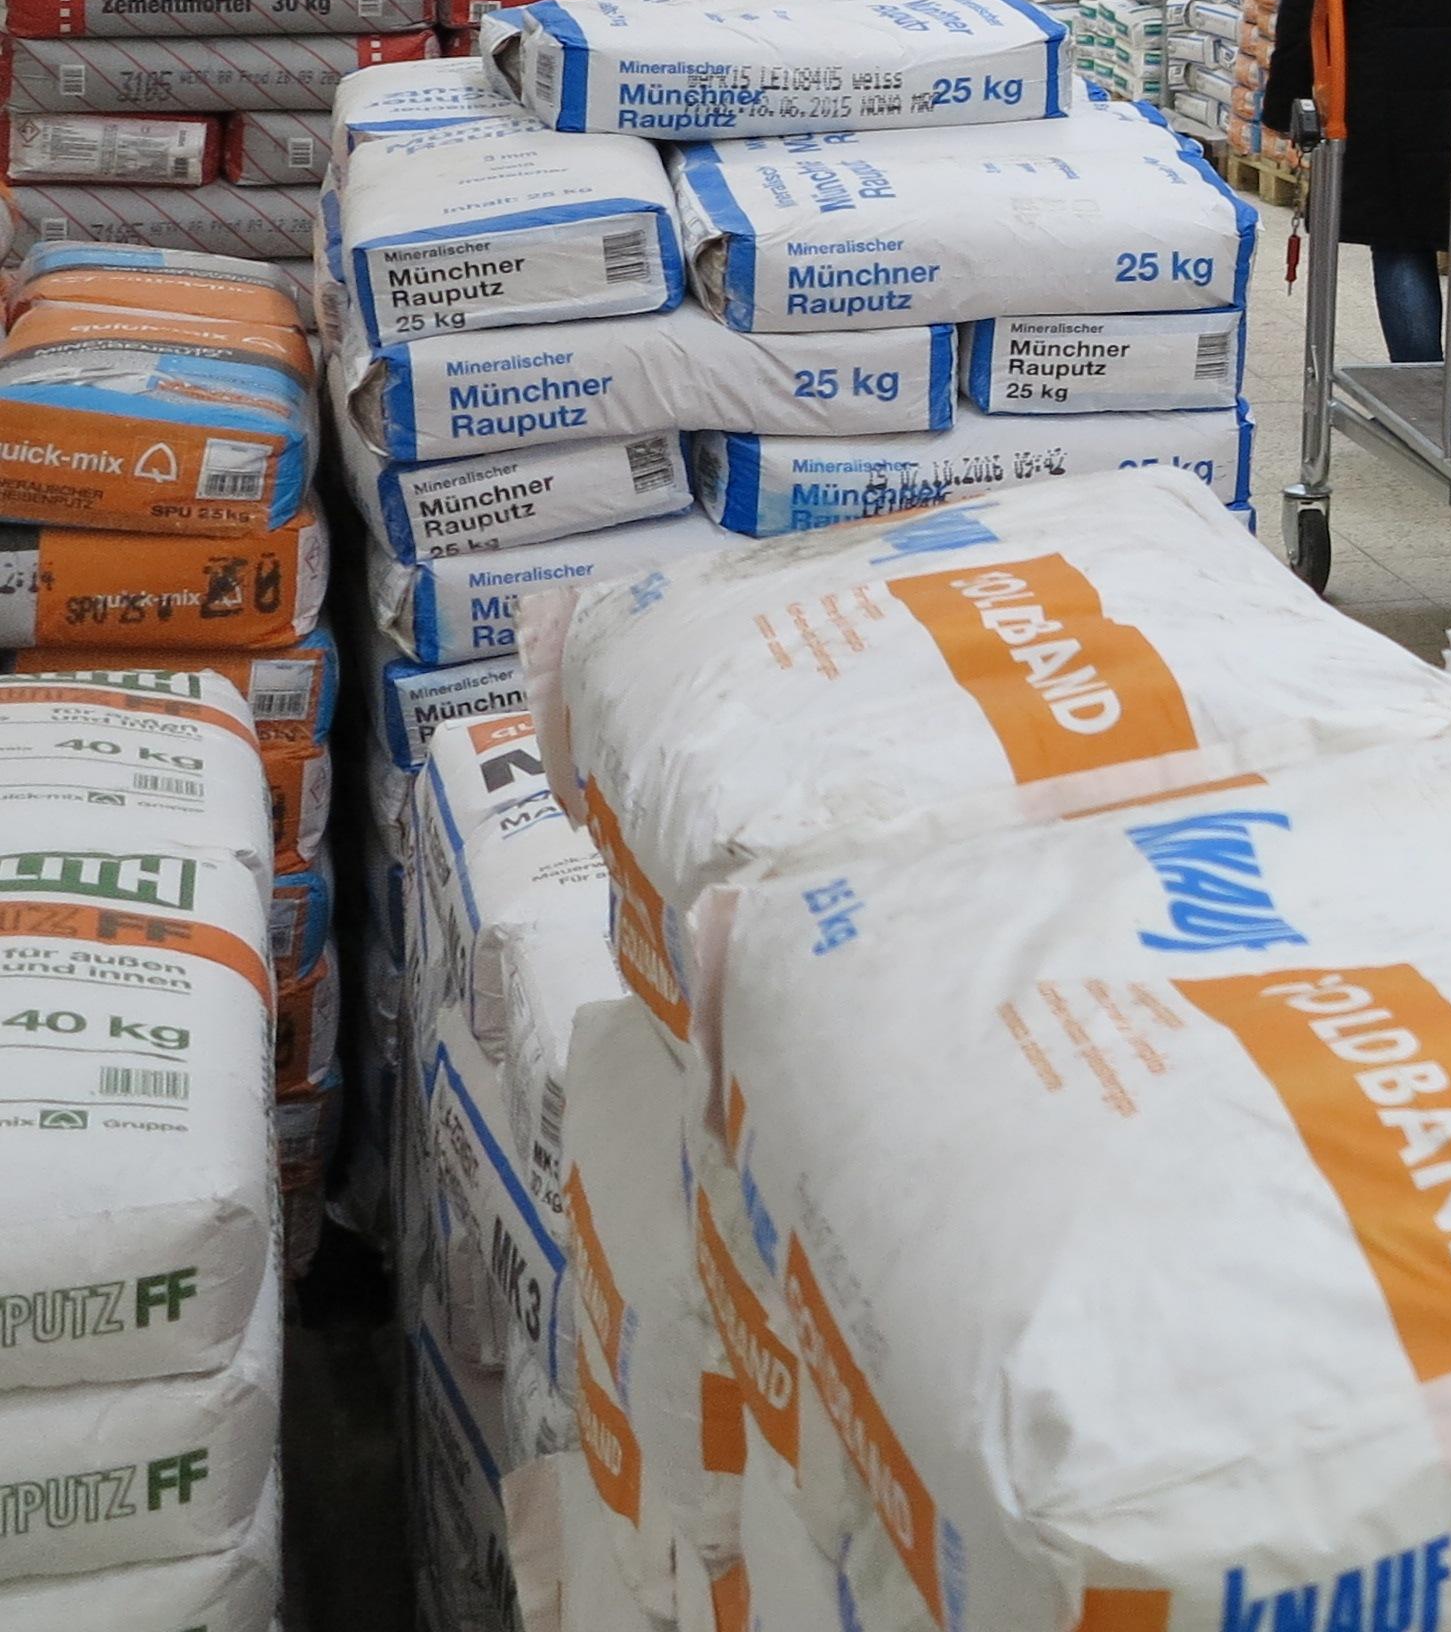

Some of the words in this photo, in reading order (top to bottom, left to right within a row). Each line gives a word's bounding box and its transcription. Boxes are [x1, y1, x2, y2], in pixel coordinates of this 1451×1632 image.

[932, 76, 974, 107] 25
[981, 75, 1023, 108] kg
[384, 239, 491, 264] Mineralischer
[786, 236, 905, 259] Mineralischer
[387, 254, 525, 288] Münchner
[788, 260, 941, 290] Münchner
[1114, 253, 1163, 282] 25
[1171, 252, 1215, 289] kg
[389, 278, 505, 309] Rauputz
[786, 288, 912, 318] Rauputz
[394, 313, 426, 333] 25
[434, 309, 466, 331] kg
[1009, 321, 1105, 337] Mineralischer
[445, 349, 574, 378] Mineralischer
[1009, 338, 1131, 361] Münchner
[1008, 357, 1108, 380] Rauputz
[447, 372, 613, 411] Münchner
[793, 371, 841, 400] 25
[850, 369, 901, 404] kg
[1006, 383, 1034, 403] 25
[1040, 382, 1070, 404] kg
[449, 404, 588, 439] Rauputz
[1123, 809, 1314, 954] KNAUF
[2, 1010, 86, 1033] 40
[109, 1016, 190, 1050] kg
